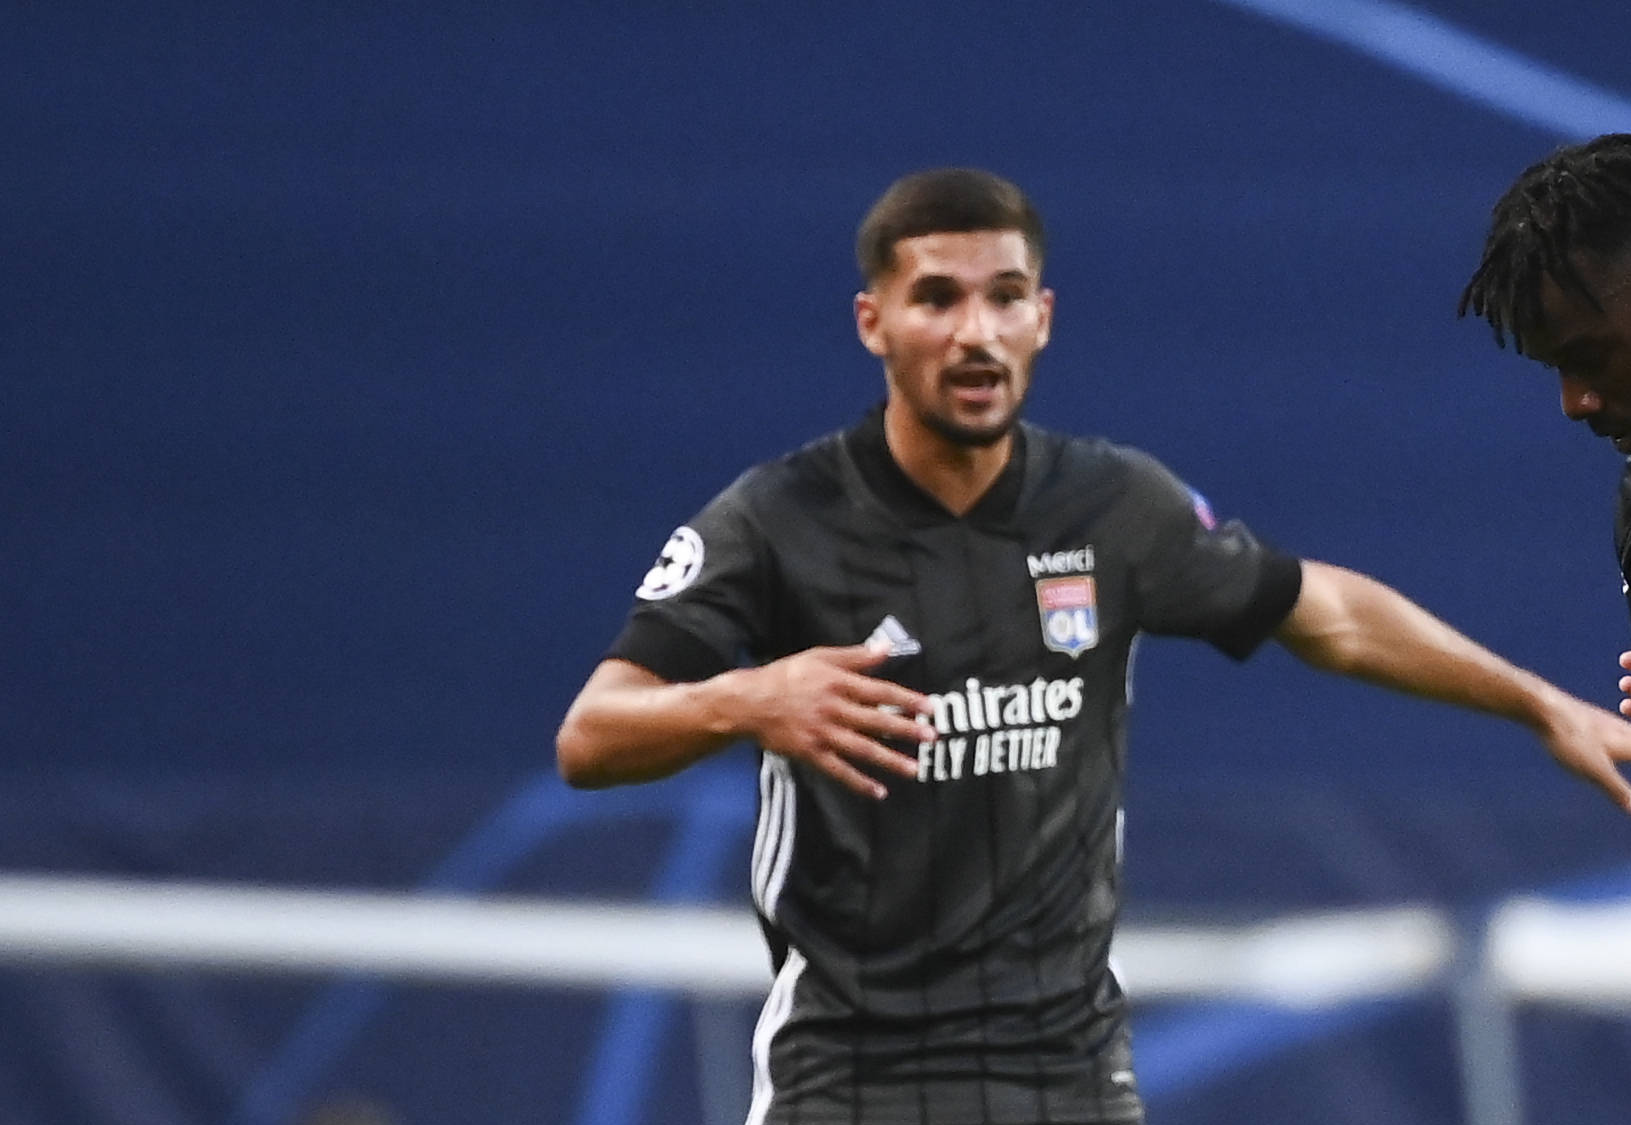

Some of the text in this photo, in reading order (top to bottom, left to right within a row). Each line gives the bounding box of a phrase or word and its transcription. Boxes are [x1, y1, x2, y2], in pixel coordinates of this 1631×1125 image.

[1027, 544, 1095, 578] Merci
[927, 676, 1084, 735] mirates
[973, 725, 1062, 777] BETTER
